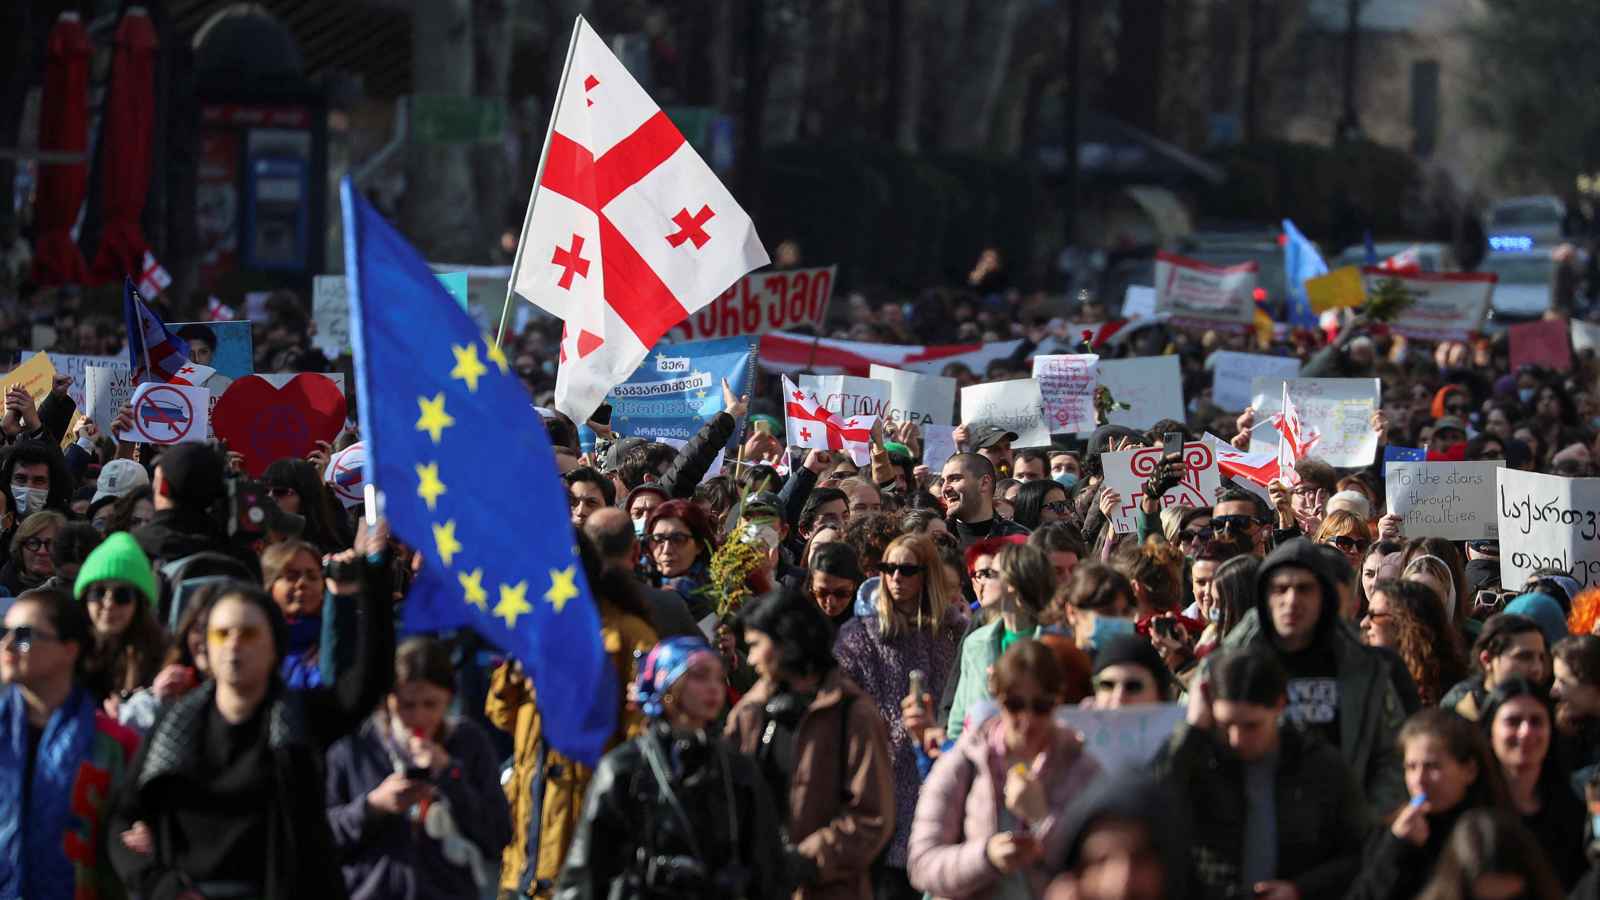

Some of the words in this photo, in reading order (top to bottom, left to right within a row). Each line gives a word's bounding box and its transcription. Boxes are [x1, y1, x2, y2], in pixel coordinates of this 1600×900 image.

[891, 408, 934, 425] GIPA
[1394, 468, 1411, 485] To
[1416, 464, 1440, 485] the
[1500, 484, 1600, 540] საქართვ
